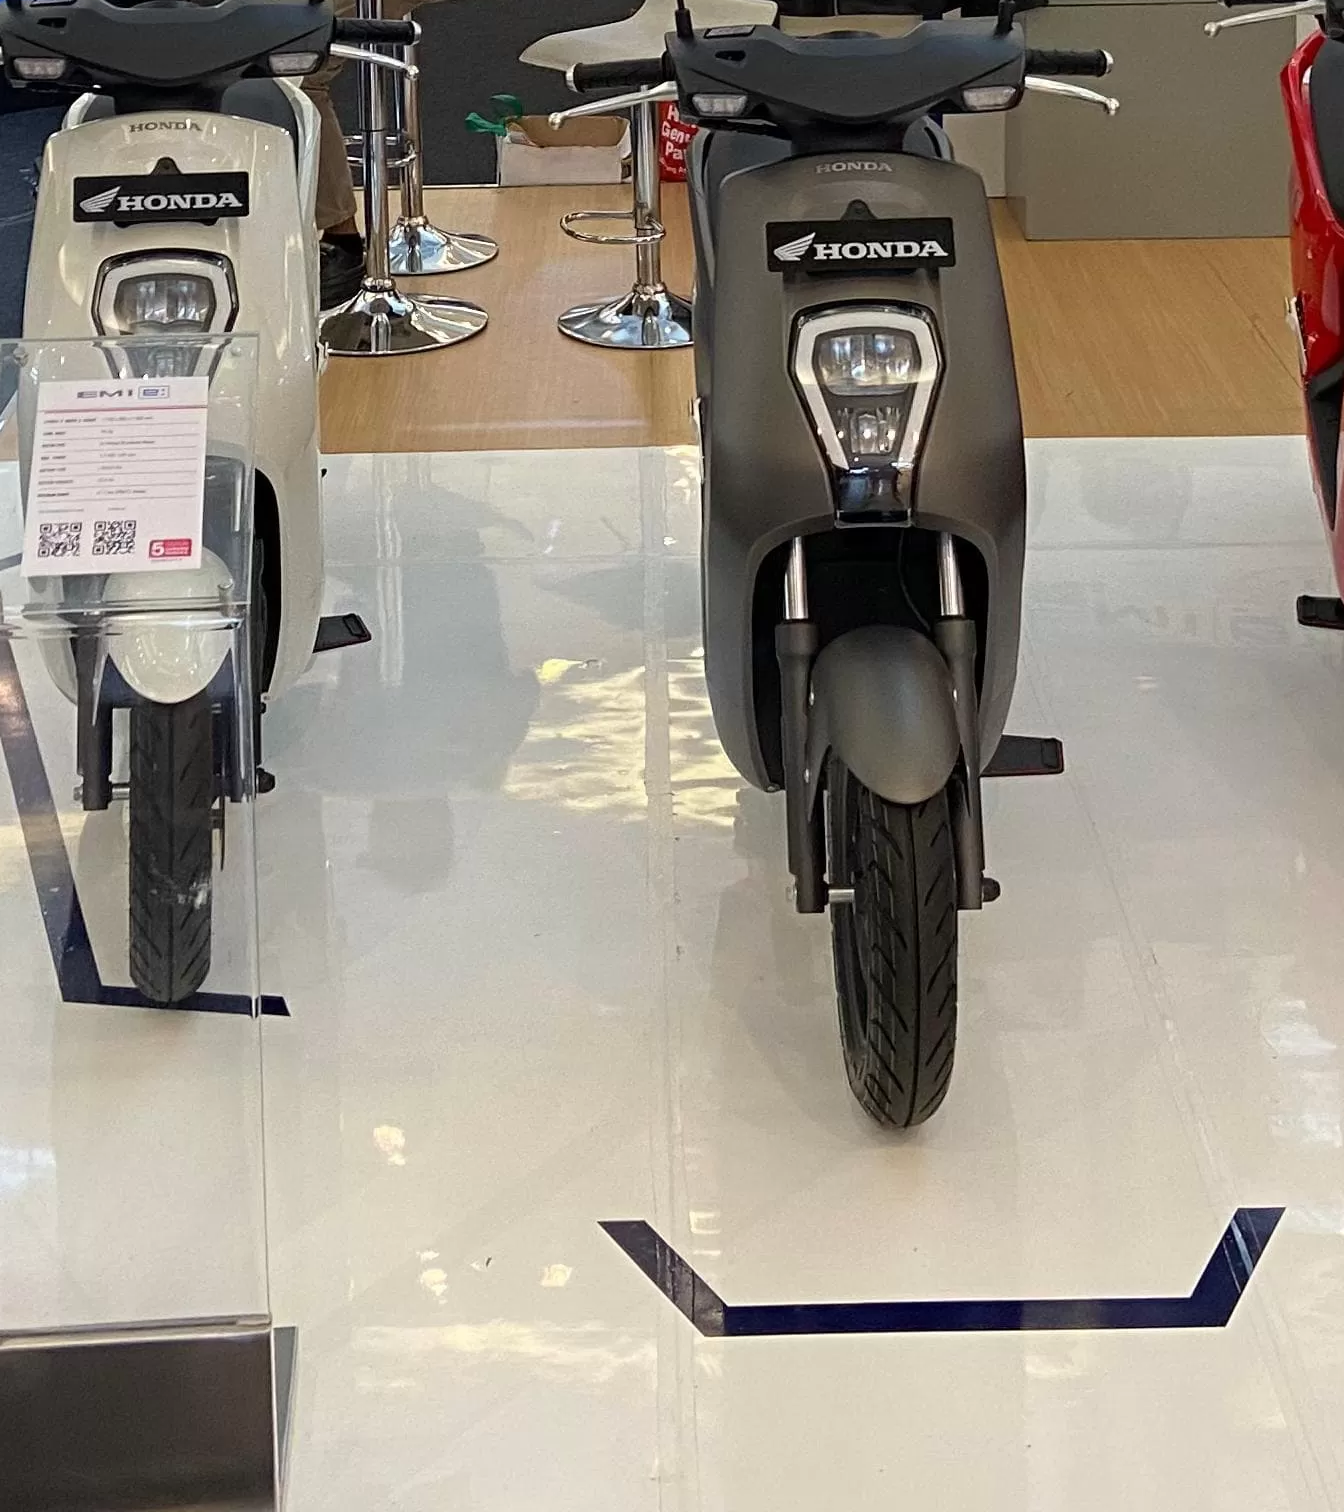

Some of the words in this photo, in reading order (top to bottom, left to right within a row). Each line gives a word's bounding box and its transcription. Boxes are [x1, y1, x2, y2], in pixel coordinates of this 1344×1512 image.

[129, 120, 202, 133] HONDA
[815, 161, 893, 174] HONDA
[117, 193, 242, 211] HONDA
[814, 241, 949, 261] HONDA
[77, 390, 133, 399] EM1
[151, 541, 165, 556] 5
